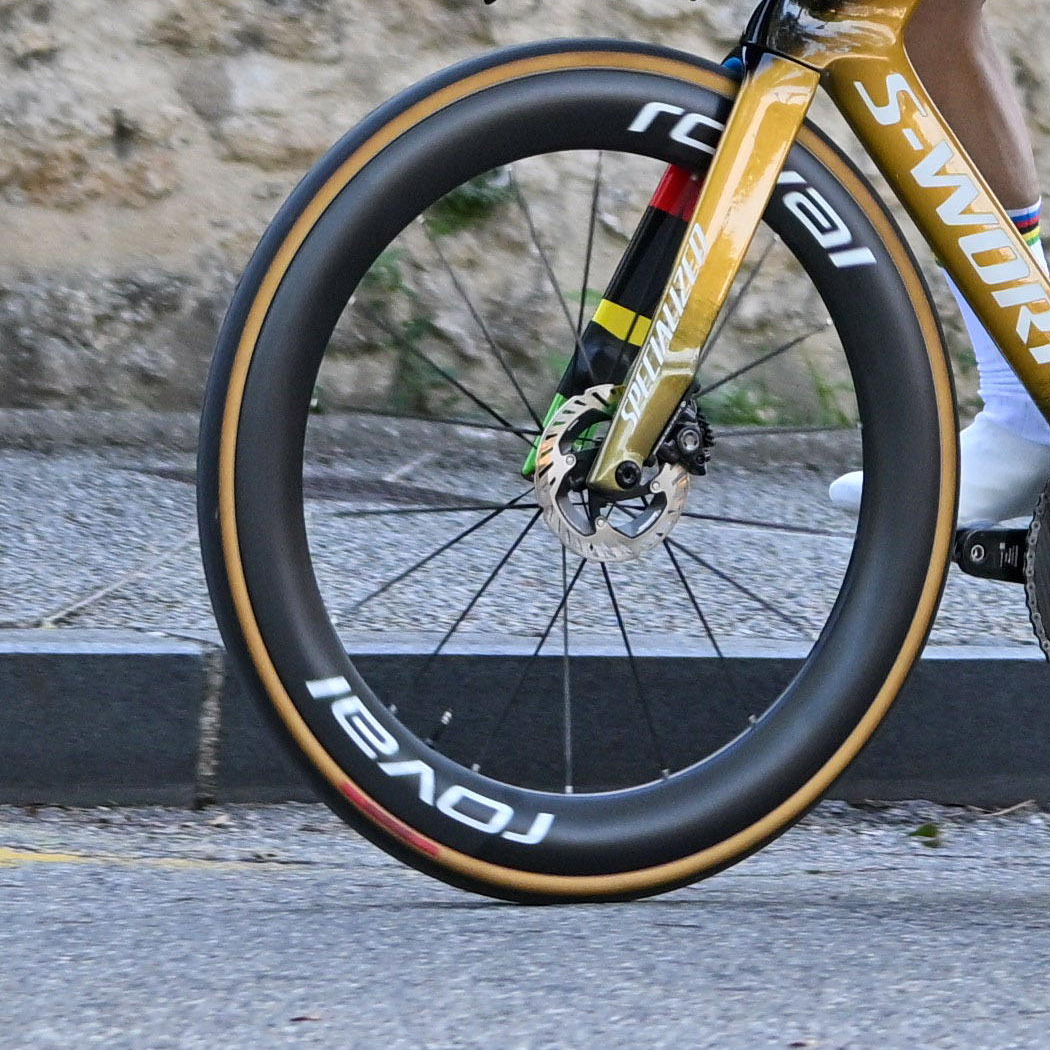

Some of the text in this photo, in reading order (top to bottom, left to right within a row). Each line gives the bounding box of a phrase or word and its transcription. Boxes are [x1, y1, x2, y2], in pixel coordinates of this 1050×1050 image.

[627, 101, 876, 269] roal
[619, 222, 708, 428] SPECIALIZED
[305, 674, 556, 845] roval
